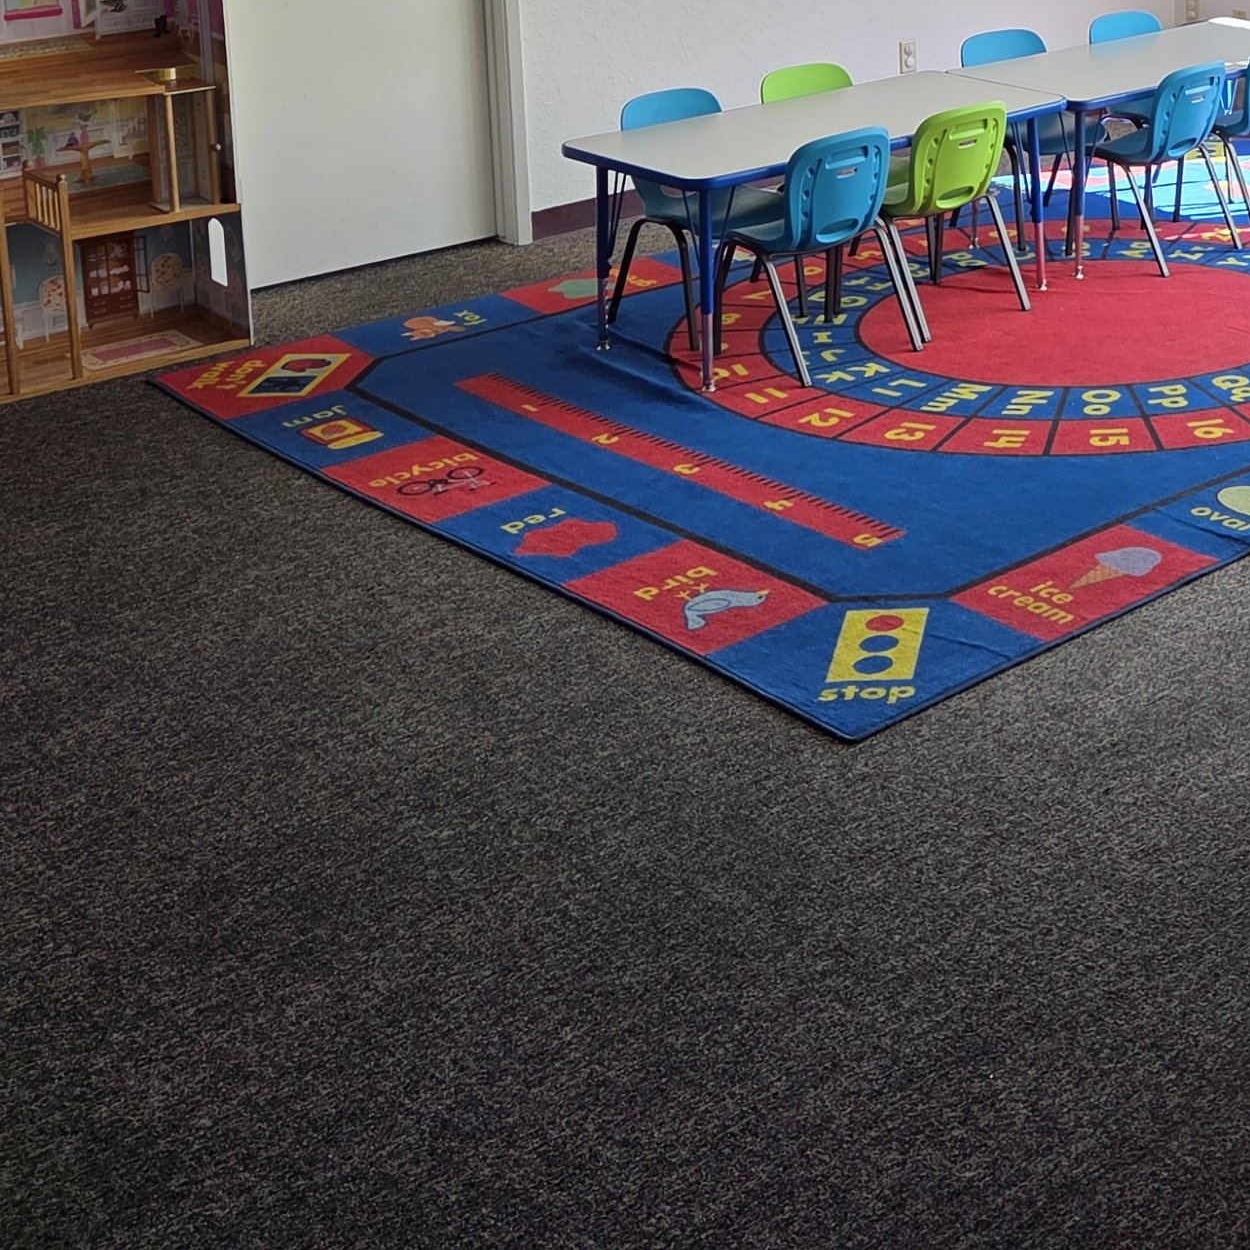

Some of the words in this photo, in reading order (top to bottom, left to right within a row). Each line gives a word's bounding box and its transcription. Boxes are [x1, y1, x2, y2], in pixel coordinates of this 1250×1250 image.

[454, 309, 487, 327] fox
[186, 361, 236, 390] walk
[744, 387, 790, 405] 11
[920, 383, 993, 413] Mm
[1001, 390, 1054, 415] Nn
[1081, 389, 1121, 415] Oo
[281, 405, 348, 429] jam
[797, 407, 856, 428] 12
[591, 433, 620, 445] 2
[883, 422, 937, 441] 13
[983, 428, 1031, 448] 14
[1089, 427, 1130, 447] 15
[1186, 418, 1235, 439] 16
[368, 452, 480, 488] bicycle
[673, 463, 700, 475] 3
[763, 499, 794, 511] 4
[499, 507, 567, 534] red
[852, 533, 882, 547] 5
[632, 565, 717, 602] bird
[1029, 581, 1074, 606] ice
[987, 583, 1075, 625] cream
[817, 684, 916, 704] stop
